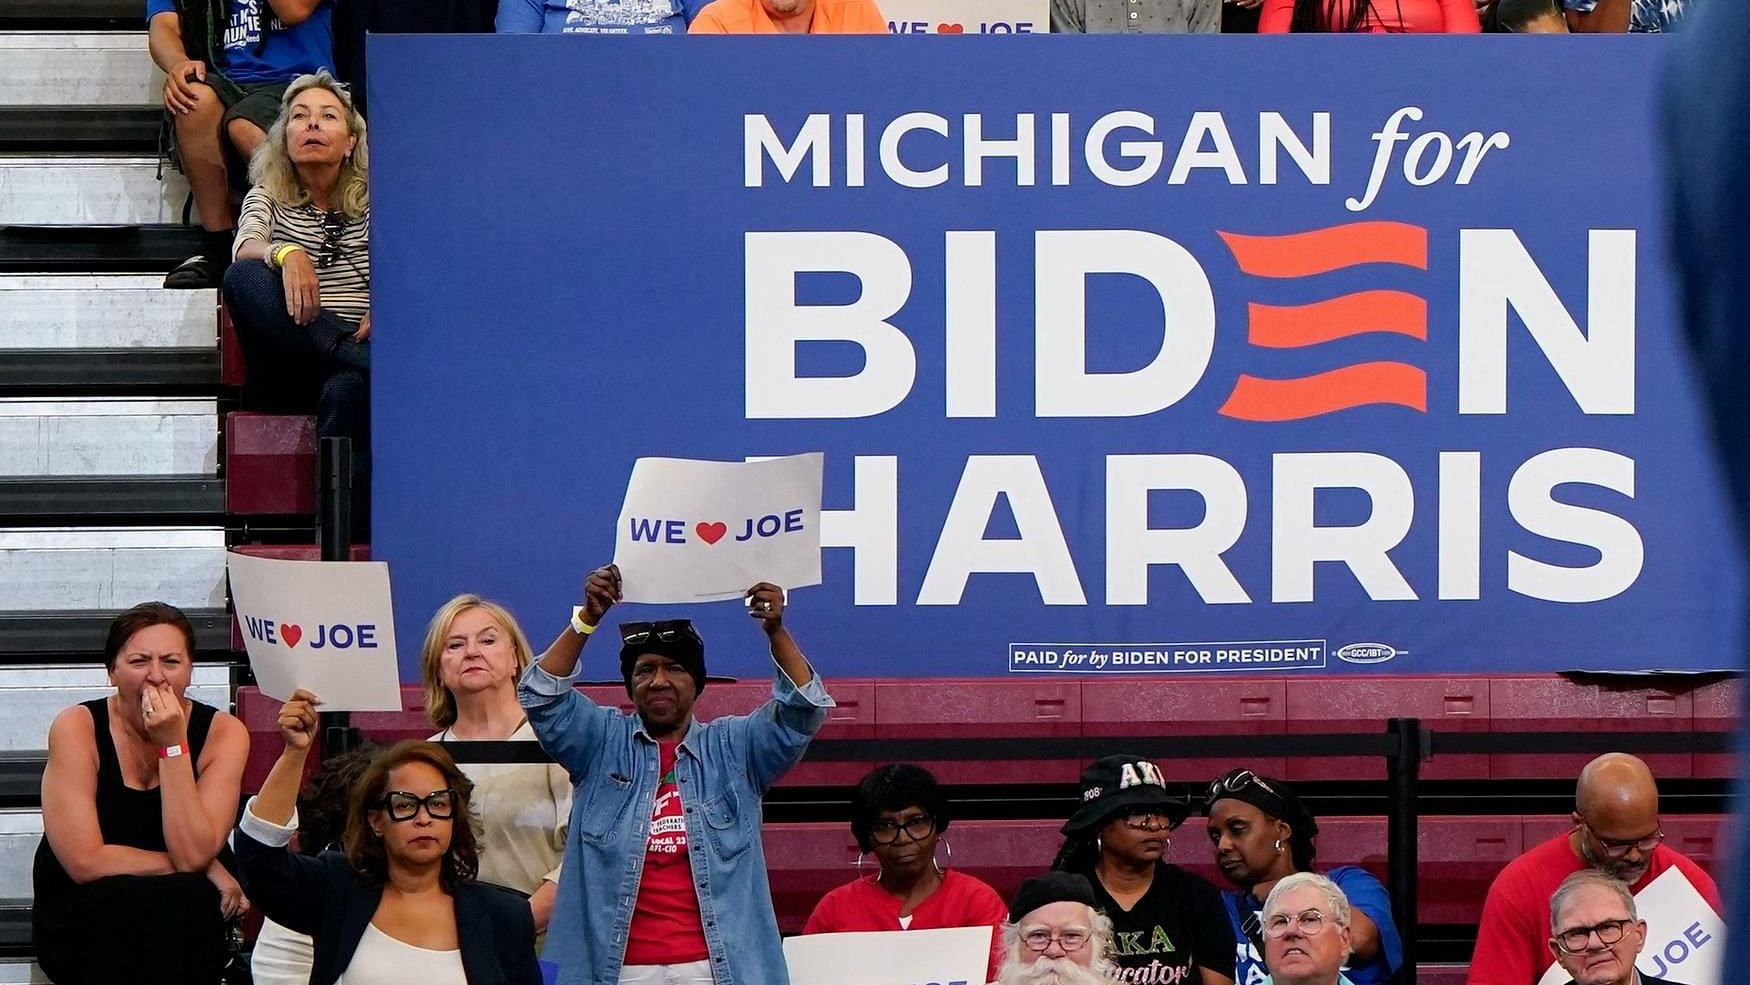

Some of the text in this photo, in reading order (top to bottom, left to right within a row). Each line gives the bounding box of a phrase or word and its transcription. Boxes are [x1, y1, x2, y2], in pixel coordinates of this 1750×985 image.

[745, 107, 1509, 212] MICHIGAN for
[745, 222, 1636, 421] BIDEN
[630, 509, 803, 543] WE JOE
[745, 448, 1645, 606] HARRIS
[245, 616, 377, 648] WE JOE
[1014, 648, 1320, 669] PAID for by BIDEN FOR PRESIDENT
[1652, 921, 1712, 978] JOE
